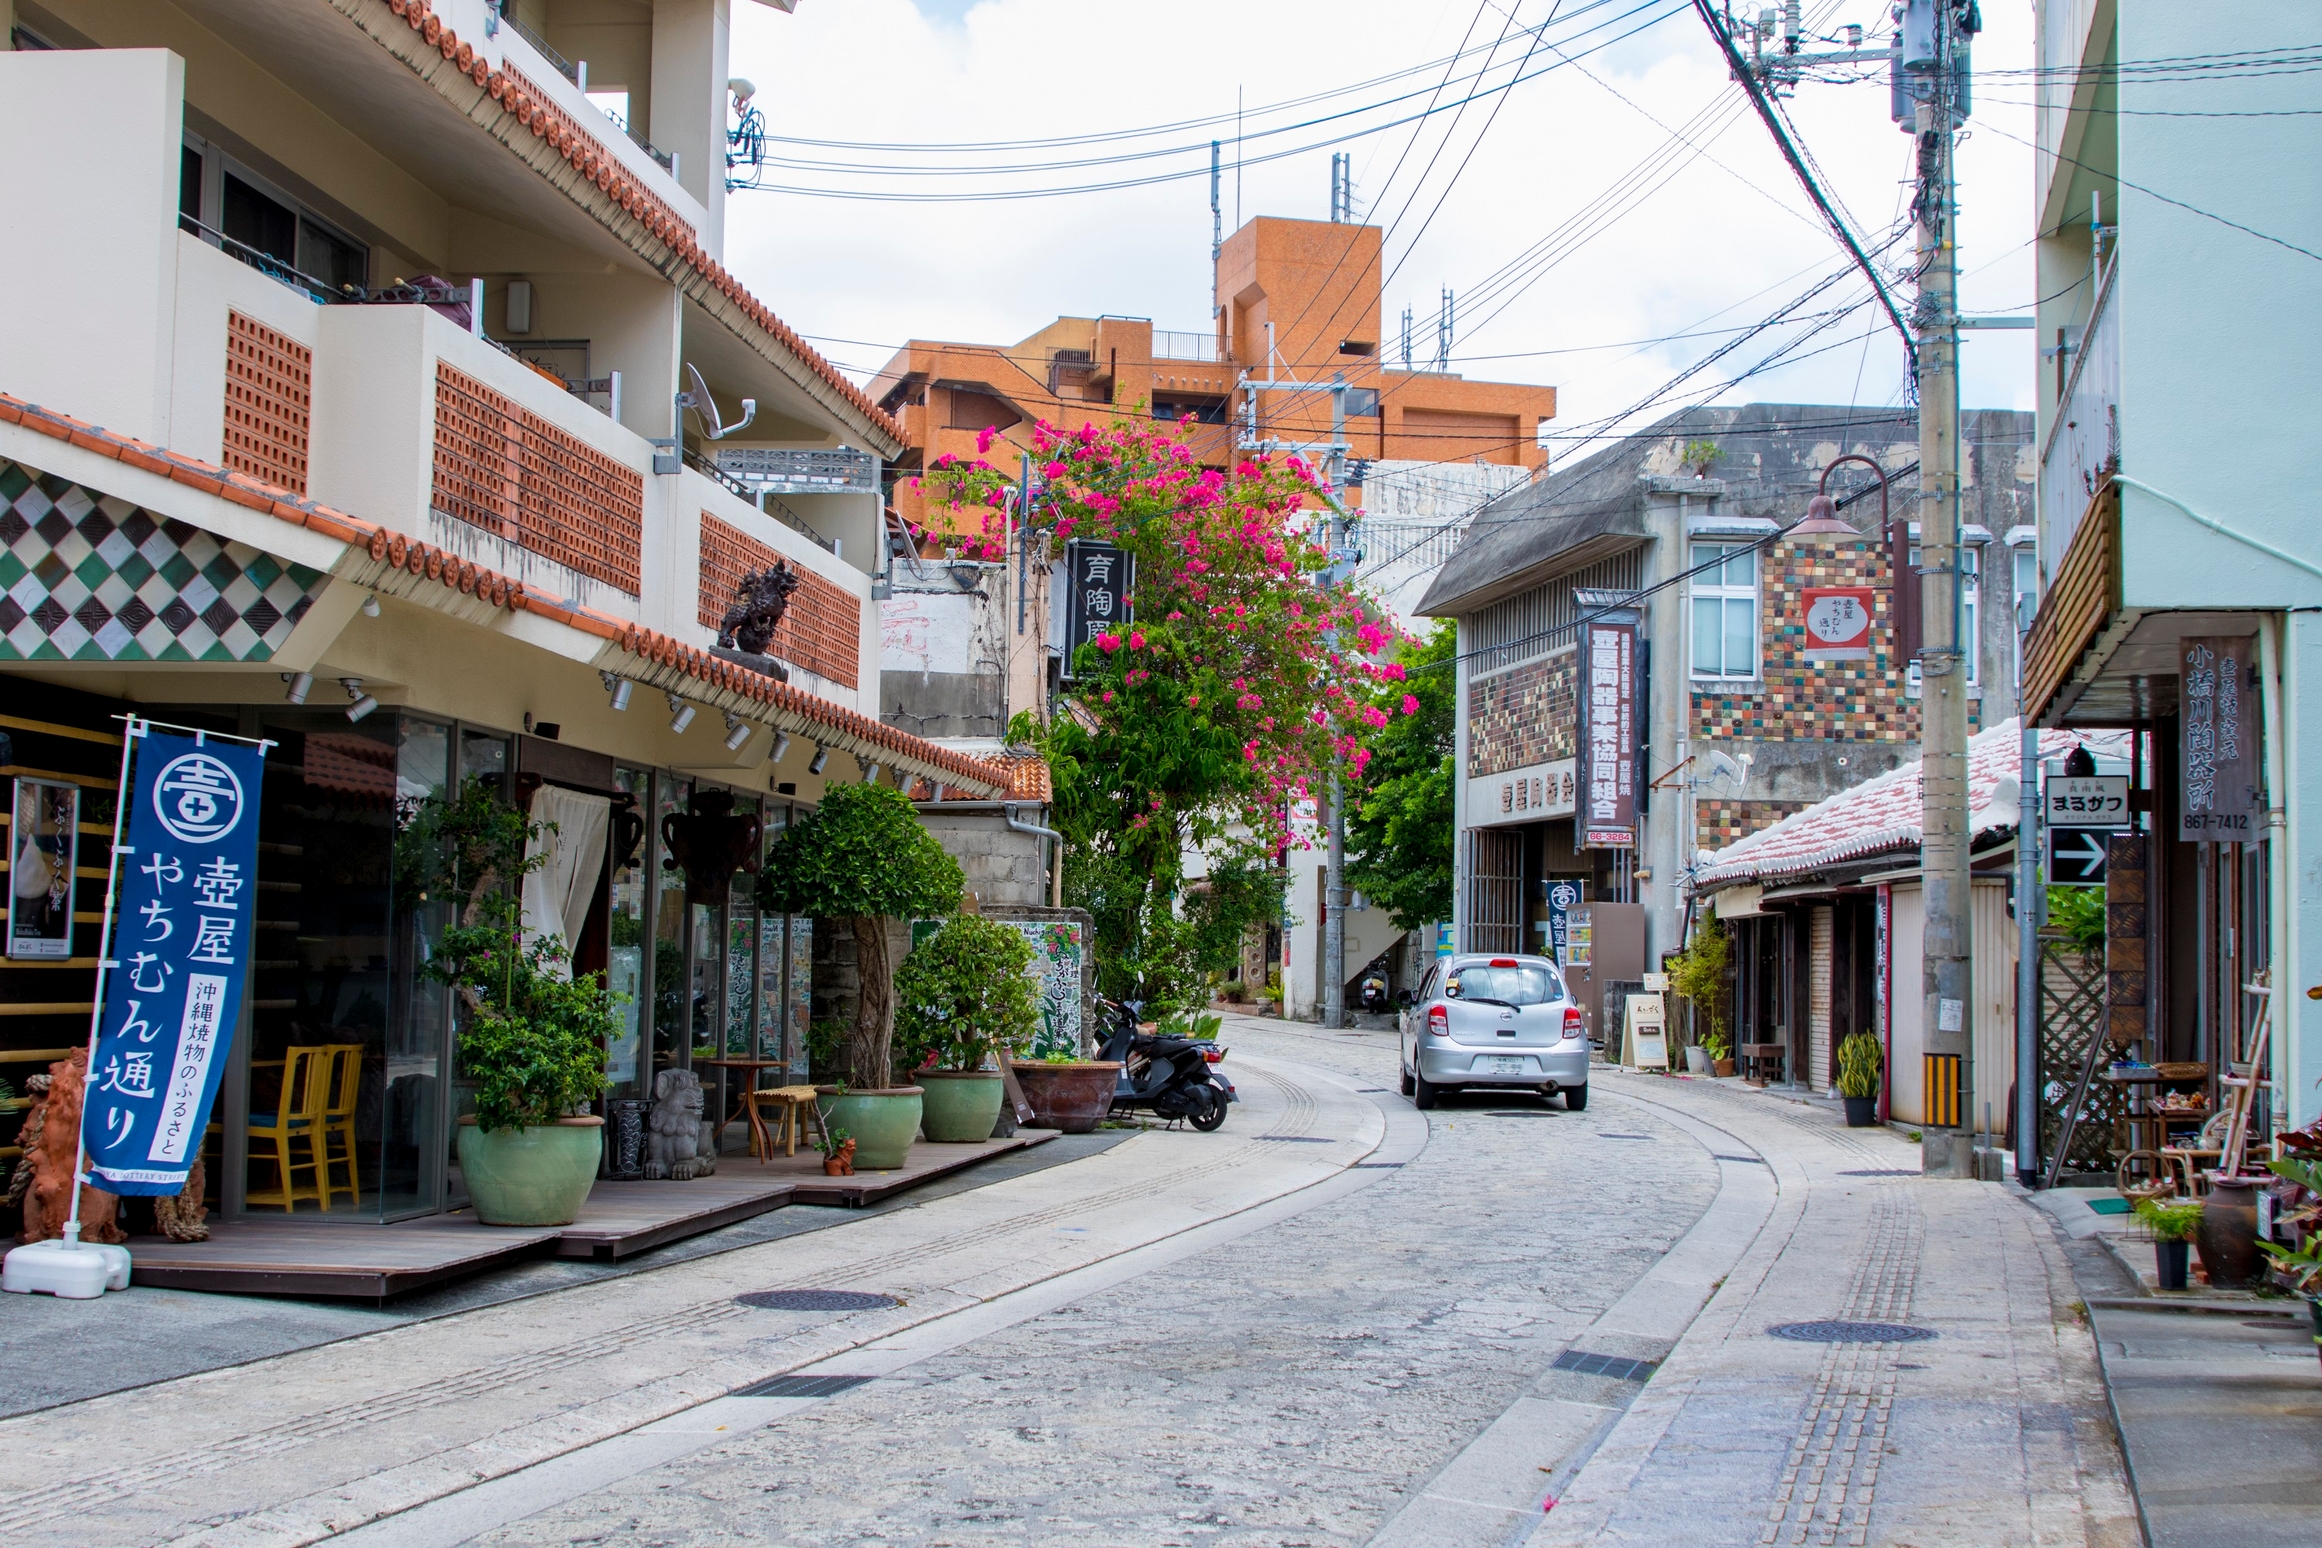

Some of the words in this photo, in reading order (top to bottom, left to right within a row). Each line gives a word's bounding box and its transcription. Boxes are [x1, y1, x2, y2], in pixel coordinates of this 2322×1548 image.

[1819, 618, 1829, 637] 通り
[2184, 814, 2248, 830] 867-7412
[1590, 833, 1630, 841] 66-3284
[100, 853, 184, 1150] やちむん通り
[162, 982, 217, 1155] 沖縄焼物のふるさと
